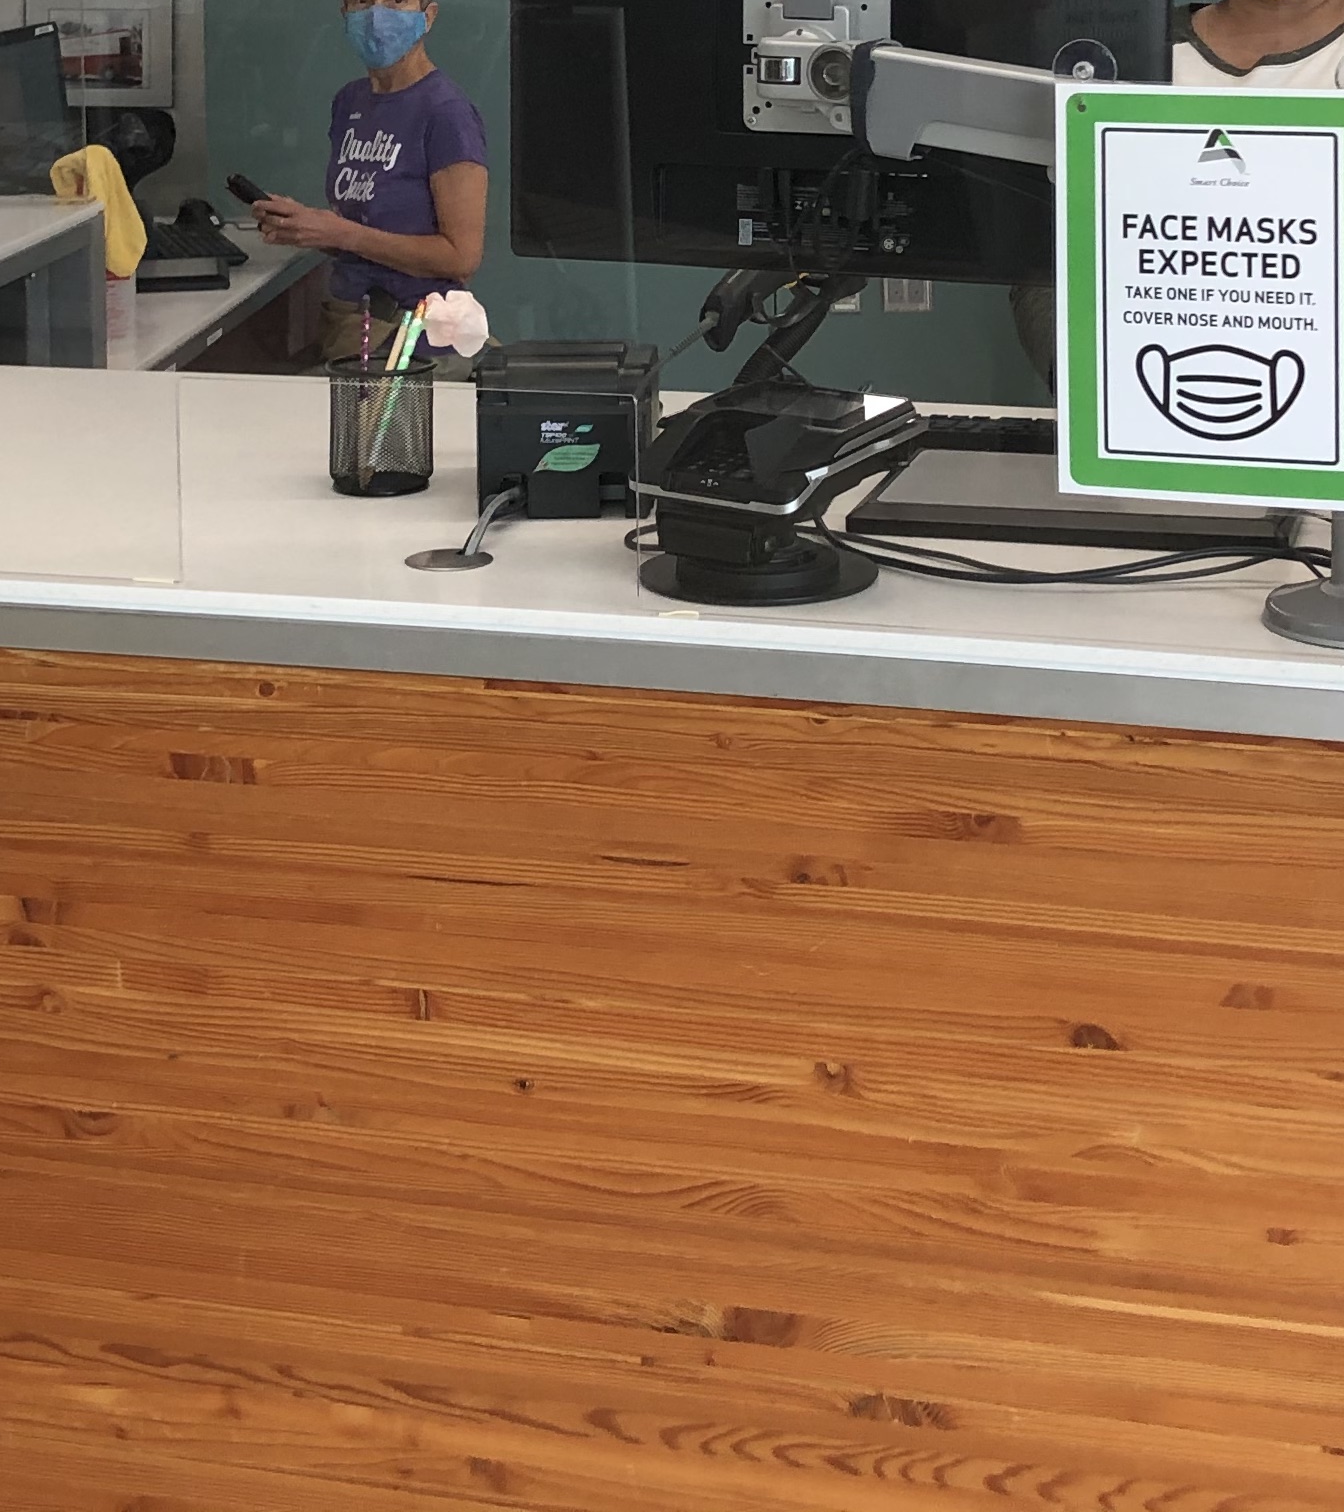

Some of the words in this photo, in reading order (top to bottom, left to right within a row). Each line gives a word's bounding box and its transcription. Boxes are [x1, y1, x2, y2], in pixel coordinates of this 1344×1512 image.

[337, 128, 402, 172] Quality
[1189, 178, 1217, 186] Smart
[1220, 178, 1251, 187] Choice
[1121, 214, 1197, 241] FACE
[1207, 217, 1318, 245] MASKS
[1138, 249, 1301, 280] EXPECTED
[1125, 285, 1163, 301] TAKE
[1166, 286, 1197, 301] ONE
[1201, 287, 1216, 303] IF
[1218, 289, 1251, 304] YOU
[1254, 290, 1295, 305] NEED
[1298, 291, 1317, 306] IT.
[1123, 310, 1174, 326] COVER
[1177, 312, 1218, 327] NOSE
[1221, 314, 1254, 329] AND
[1257, 315, 1319, 331] MOUTH.
